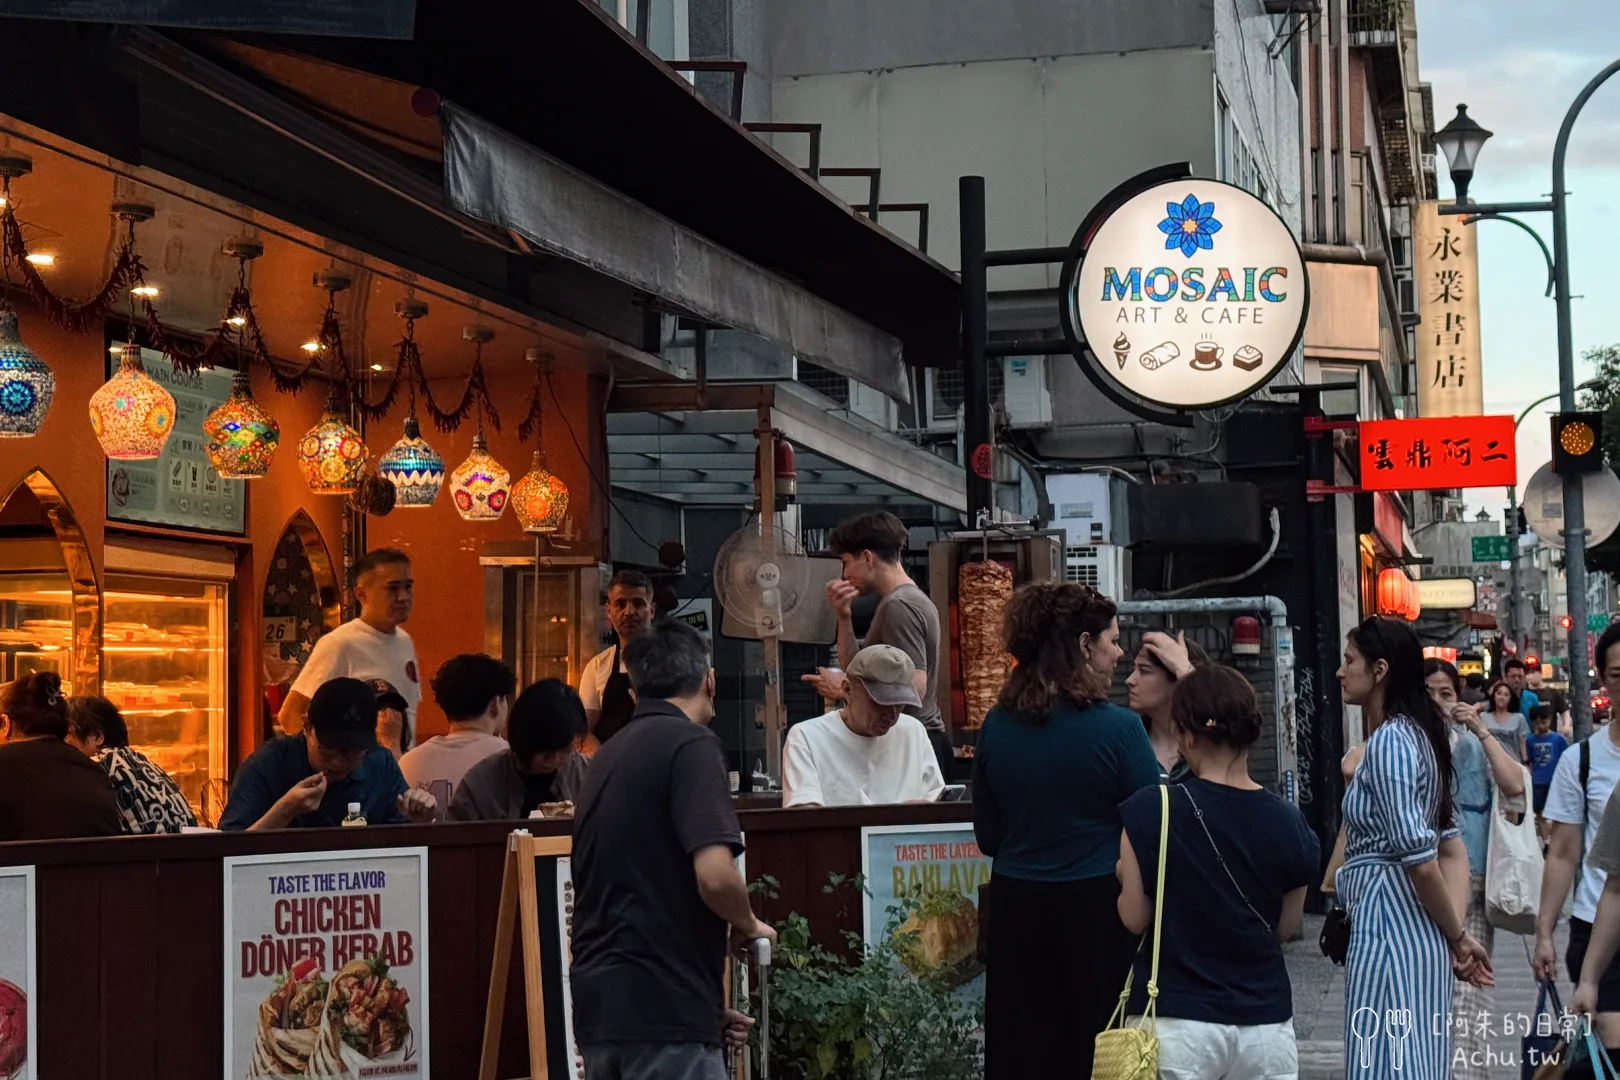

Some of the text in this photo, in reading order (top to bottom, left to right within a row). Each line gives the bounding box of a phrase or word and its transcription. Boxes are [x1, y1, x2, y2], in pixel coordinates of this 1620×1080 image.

[1101, 267, 1288, 302] MOSAIC
[1116, 307, 1264, 324] ART & CAFE
[1428, 227, 1467, 395] 永業書店
[1367, 438, 1508, 470] 雲鼎阿二
[266, 623, 286, 640] 26
[894, 844, 927, 862] TASTE
[929, 843, 947, 860] THE
[269, 871, 386, 895] TASTE THE FLAVOR
[274, 893, 382, 935] CHICKEN
[241, 931, 414, 978] DÖNER KEBAB
